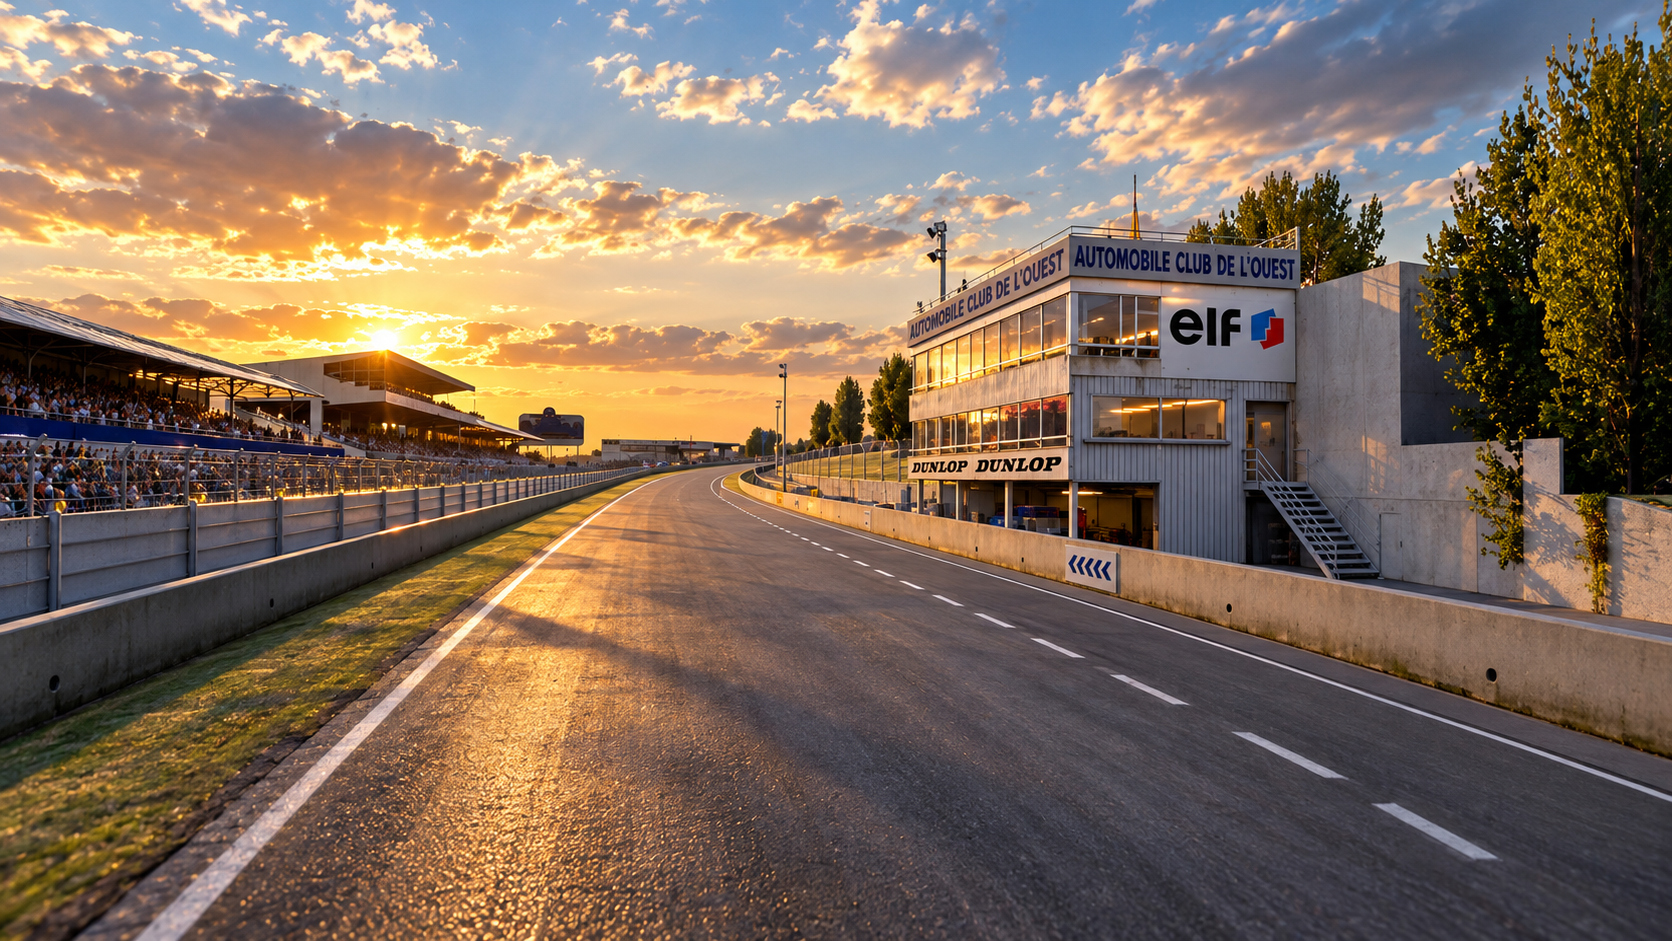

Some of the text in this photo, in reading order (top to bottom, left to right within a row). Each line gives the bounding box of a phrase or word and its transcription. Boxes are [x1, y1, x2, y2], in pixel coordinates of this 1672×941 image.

[1074, 245, 1295, 280] AUTOMOBILE CLUB DE L'OUEST
[910, 248, 1064, 339] AUTOMOBILE CLUB DE L'OUEST
[1170, 307, 1241, 346] elf
[911, 456, 1062, 480] DUNLOP DUNLOP
